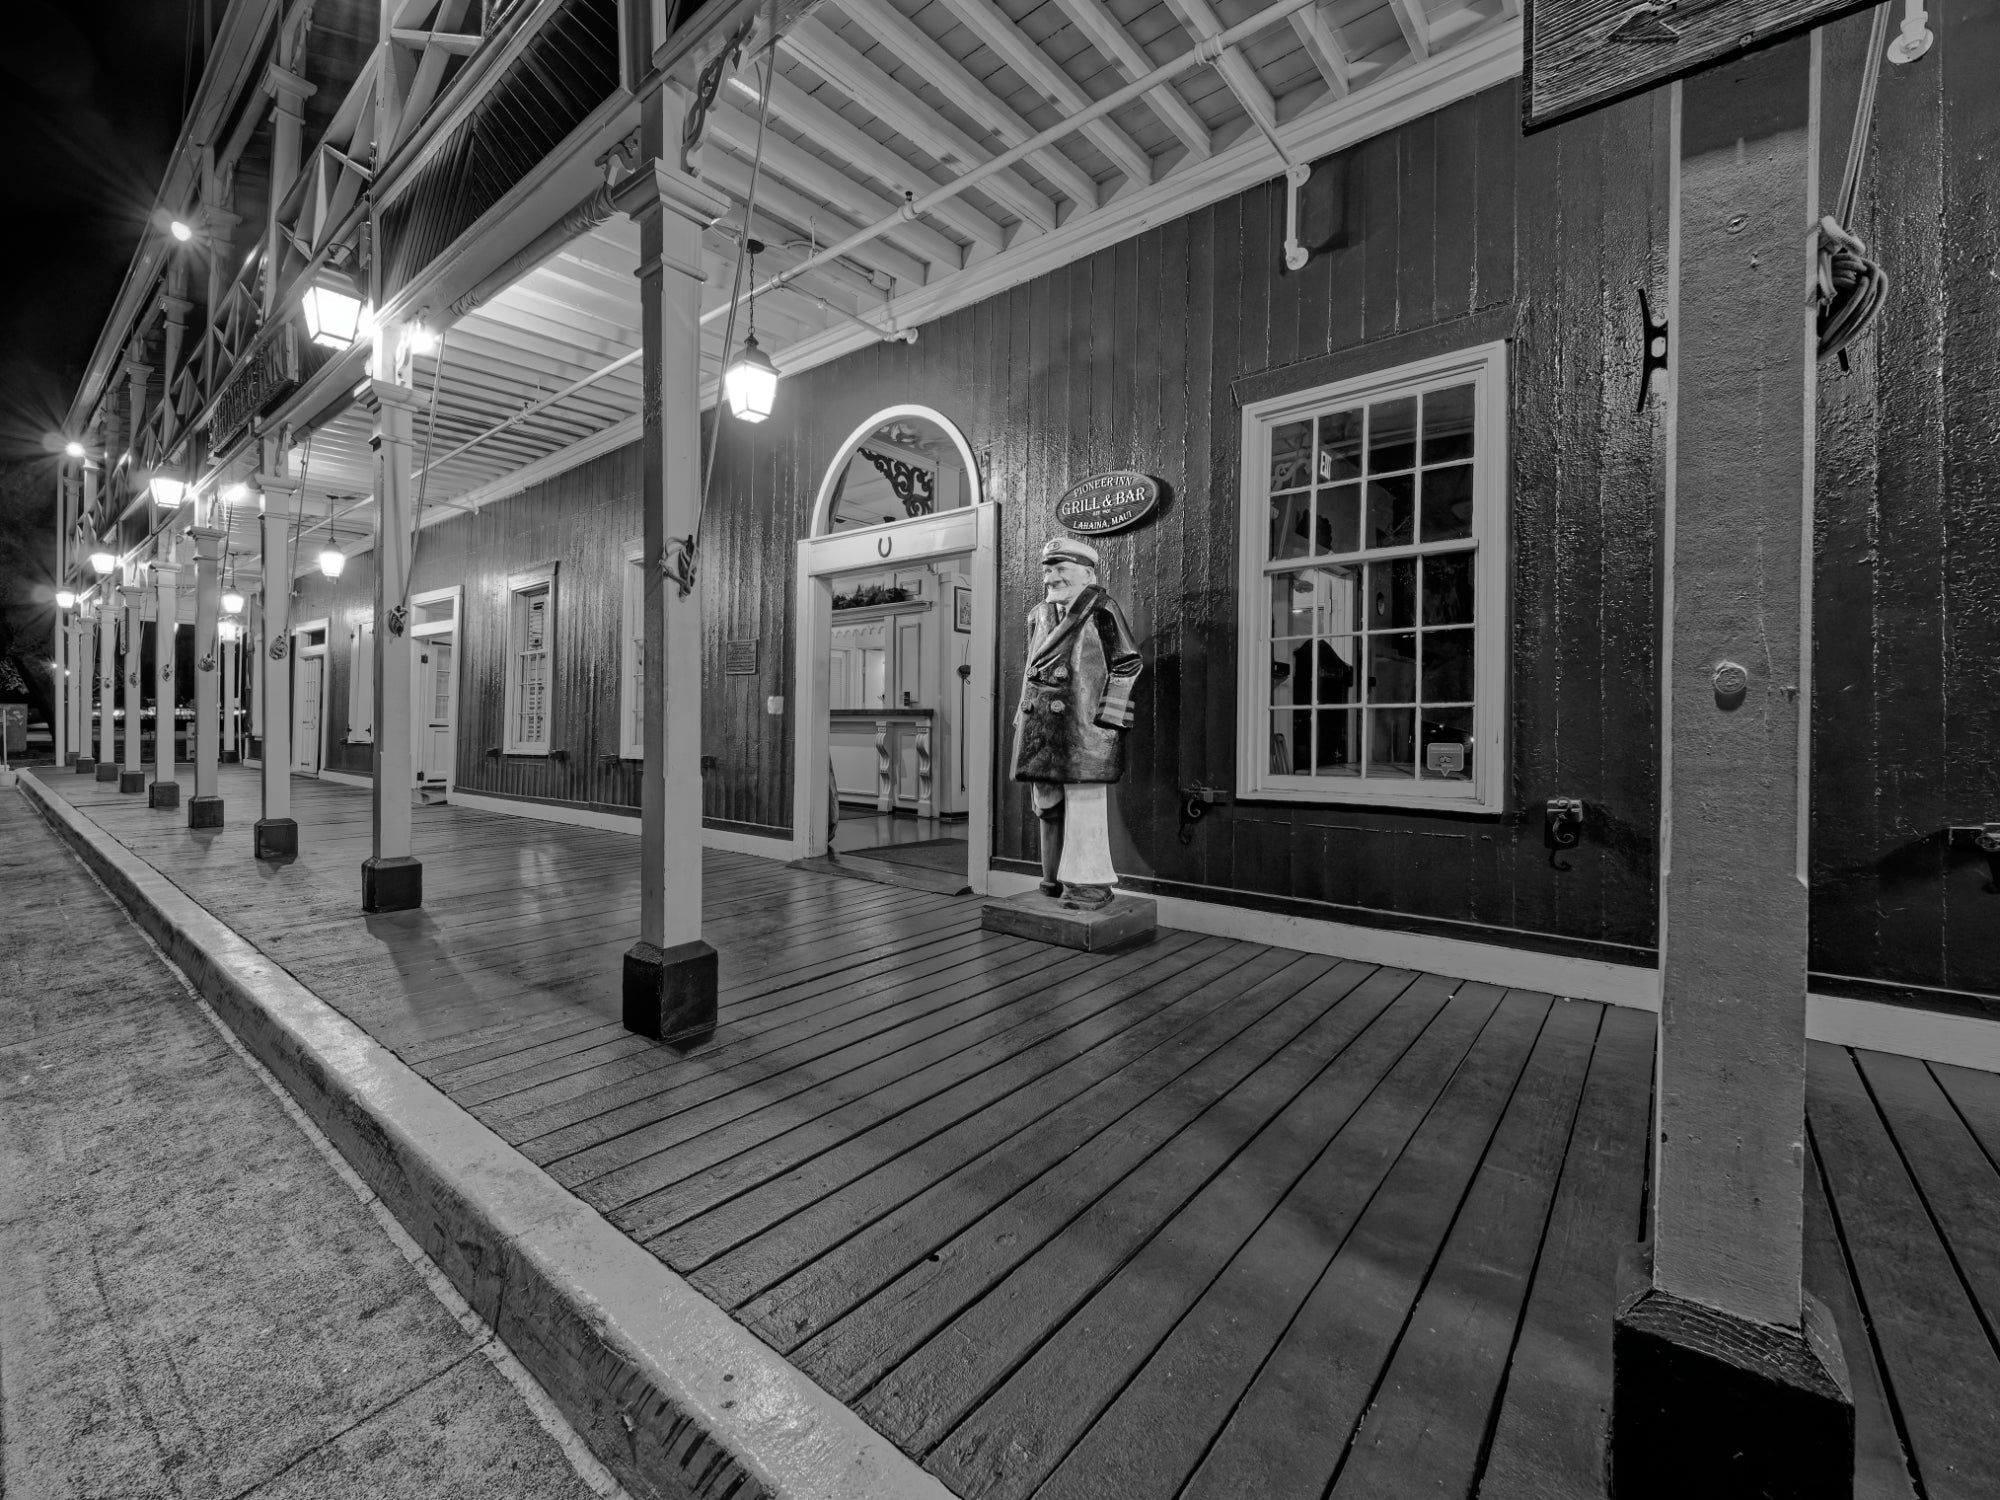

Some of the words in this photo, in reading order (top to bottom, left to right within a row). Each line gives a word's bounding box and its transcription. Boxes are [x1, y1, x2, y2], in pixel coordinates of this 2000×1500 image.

[1073, 477, 1113, 498] PIONEER
[1115, 476, 1133, 486] INN
[1062, 497, 1099, 515] GRILL
[1102, 494, 1112, 507] &
[1116, 487, 1145, 505] BAR
[1073, 520, 1110, 530] LAHAINA,
[1111, 511, 1132, 525] MAUI
